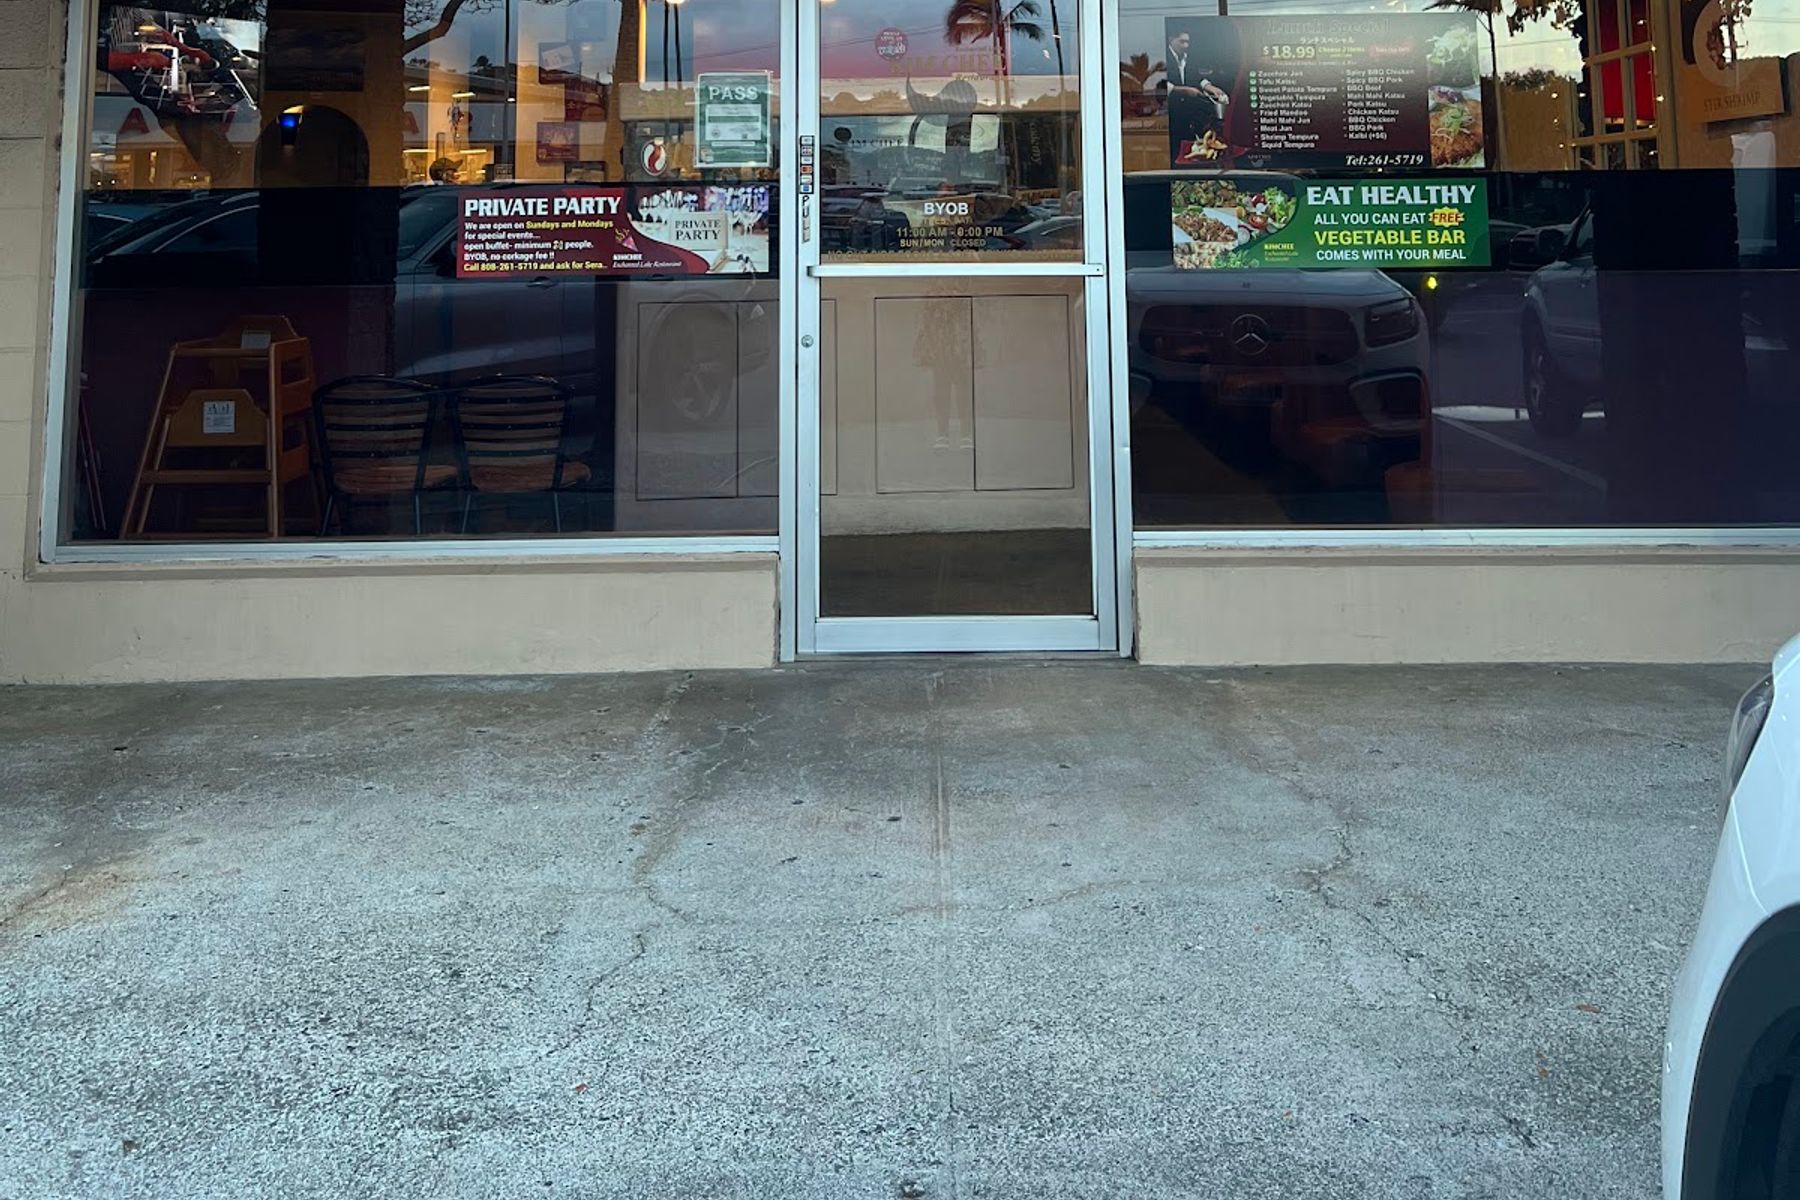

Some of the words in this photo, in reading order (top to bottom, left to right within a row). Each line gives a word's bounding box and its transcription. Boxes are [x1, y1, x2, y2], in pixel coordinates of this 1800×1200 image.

[708, 85, 759, 100] PASS
[1306, 186, 1354, 205] EAT
[1361, 185, 1476, 205] HEALTHY
[464, 198, 548, 217] PRIVATE
[554, 196, 621, 215] PARTY
[924, 202, 969, 215] BYOB
[674, 219, 721, 230] PRIVATE
[1314, 213, 1339, 225] ALL
[1341, 213, 1369, 224] YOU
[1372, 213, 1399, 224] CAN
[1402, 213, 1426, 224] EAT
[1432, 212, 1462, 223] FREE
[464, 222, 477, 230] We
[493, 223, 512, 231] open
[526, 220, 560, 231] Sundays
[561, 220, 576, 228] and
[577, 219, 613, 229] Mondays
[464, 232, 476, 240] for
[477, 231, 506, 241] special
[675, 229, 721, 241] PARTY
[928, 227, 946, 237] AM
[985, 227, 1003, 237] PM
[1314, 230, 1422, 245] VEGETABLE
[1427, 229, 1466, 244] BAR
[514, 240, 551, 249] minimum
[899, 238, 945, 247] SUN/MON
[951, 238, 987, 246] CLOSED
[1316, 250, 1359, 260] COMES
[1363, 249, 1393, 260] WITH
[1396, 249, 1430, 260] YOUR
[1432, 249, 1466, 260] MEAL
[464, 262, 480, 271] Call
[539, 261, 554, 270] and
[555, 261, 570, 270] ask
[571, 261, 584, 269] for
